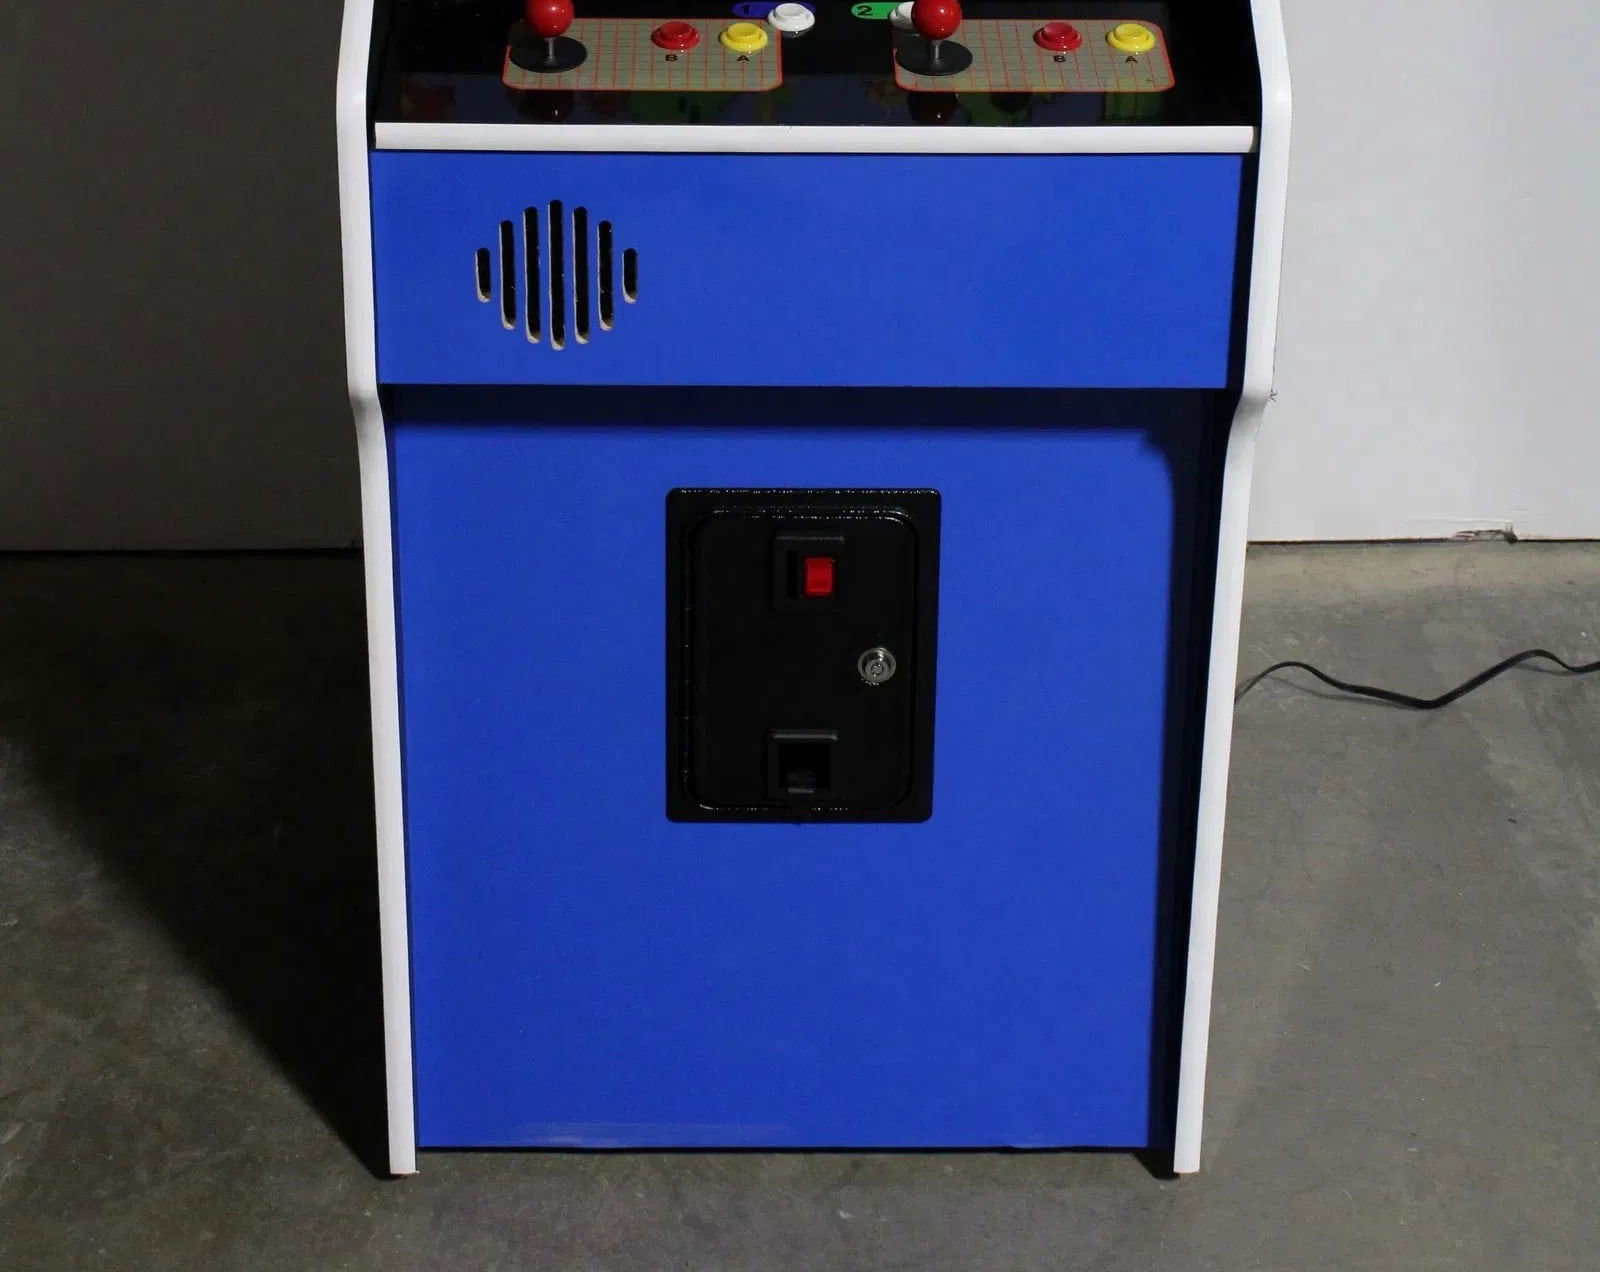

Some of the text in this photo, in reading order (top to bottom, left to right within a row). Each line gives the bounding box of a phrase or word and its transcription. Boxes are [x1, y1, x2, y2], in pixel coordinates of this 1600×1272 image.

[856, 5, 872, 16] 2
[665, 54, 678, 62] B
[737, 54, 751, 63] A
[1125, 55, 1138, 63] A
